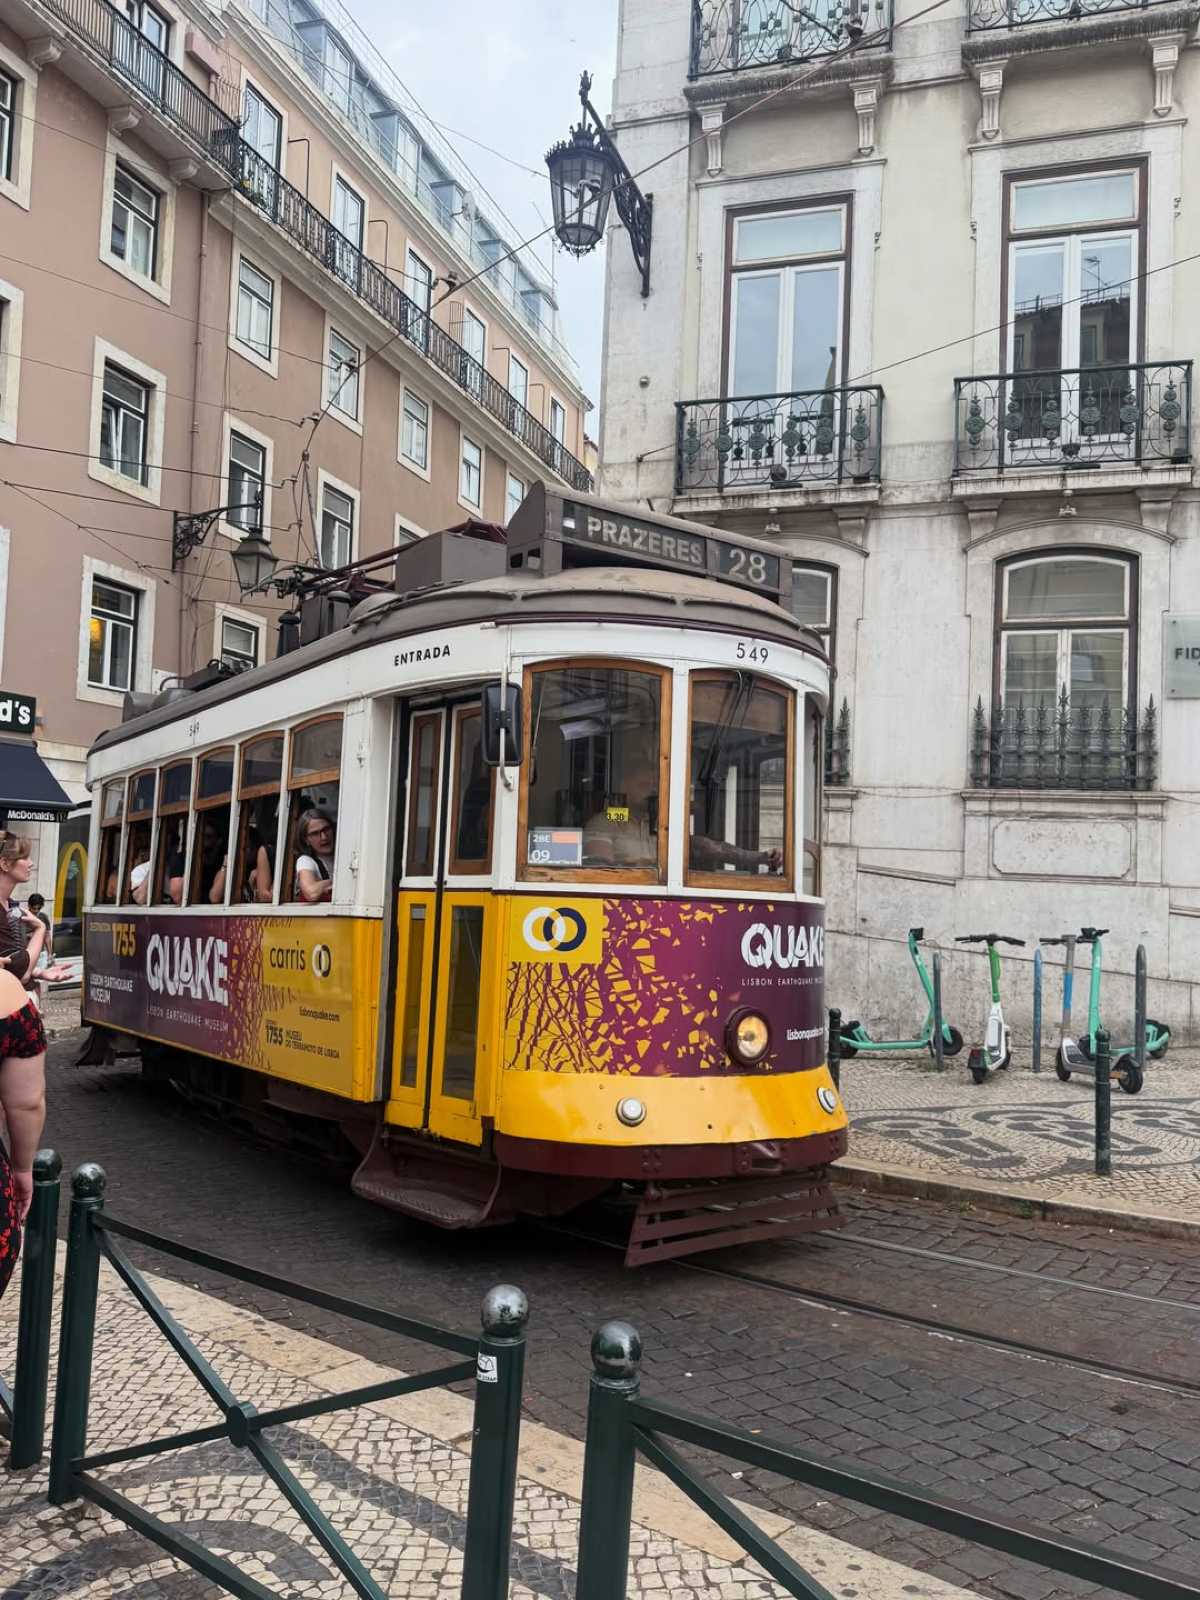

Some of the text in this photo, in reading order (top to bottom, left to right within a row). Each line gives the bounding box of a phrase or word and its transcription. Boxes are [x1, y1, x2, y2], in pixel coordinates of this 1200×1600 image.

[587, 515, 766, 585] PRAZERES 28
[394, 644, 450, 667] ENTRADA
[736, 643, 768, 664] 549
[1174, 647, 1200, 660] FID
[7, 809, 55, 822] McDonald's
[531, 849, 551, 861] 09
[111, 922, 136, 957] 1755
[269, 940, 306, 971] carris
[146, 933, 228, 1007] QUAKE
[741, 977, 773, 987] LISBON
[265, 1023, 284, 1046] 1755
